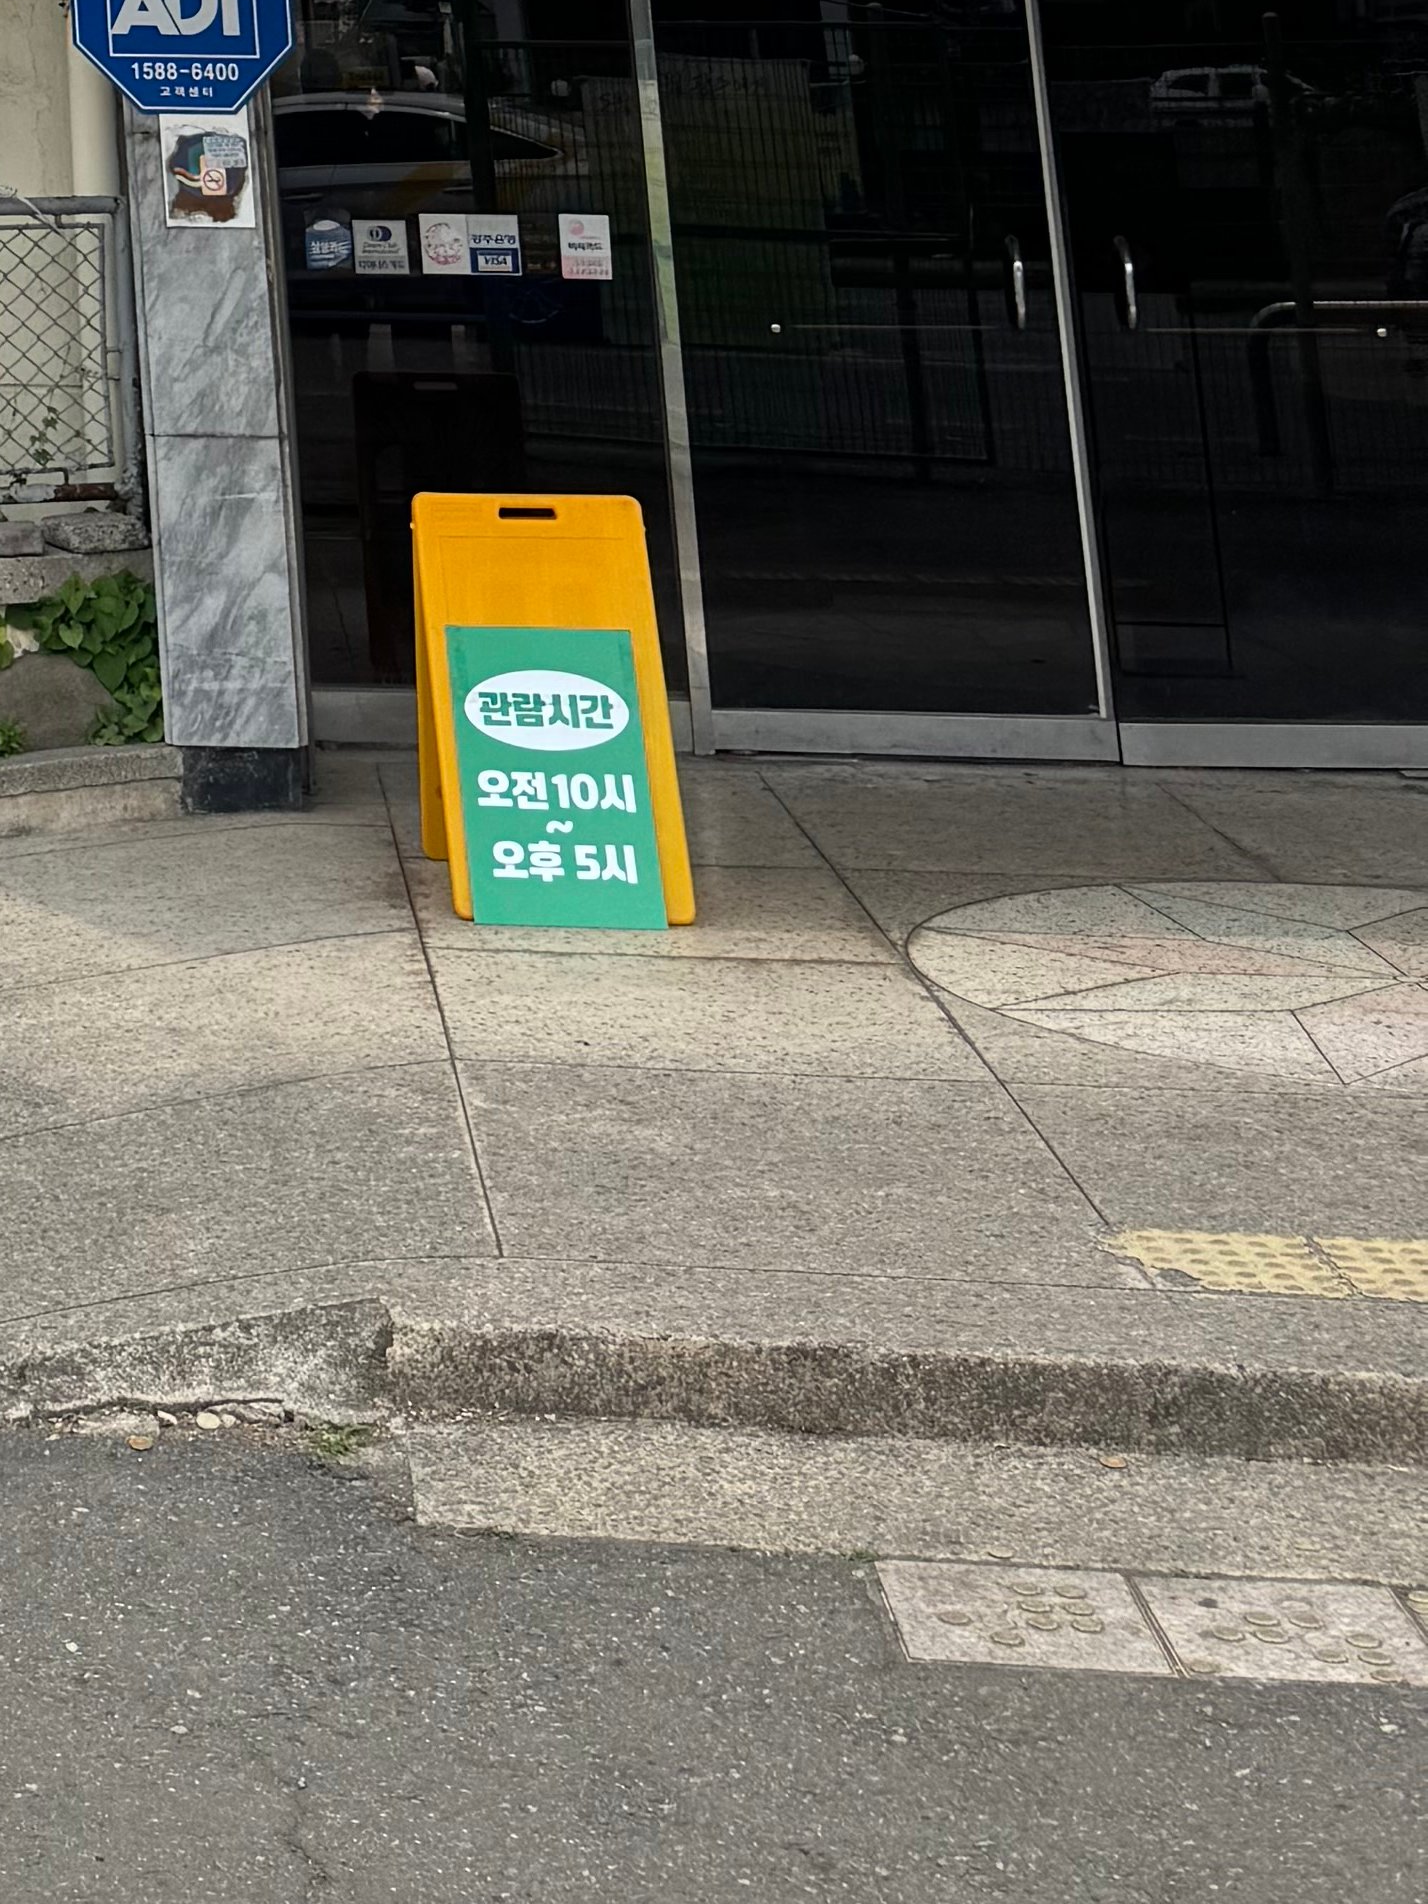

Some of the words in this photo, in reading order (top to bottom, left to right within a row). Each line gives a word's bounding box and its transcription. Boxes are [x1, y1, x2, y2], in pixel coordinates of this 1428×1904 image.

[130, 62, 240, 81] 1588-6400
[159, 85, 214, 98] 고객센터
[483, 256, 509, 267] VISA
[477, 690, 614, 730] 관람시간
[492, 840, 566, 883] 오후
[574, 843, 639, 885] 5시
